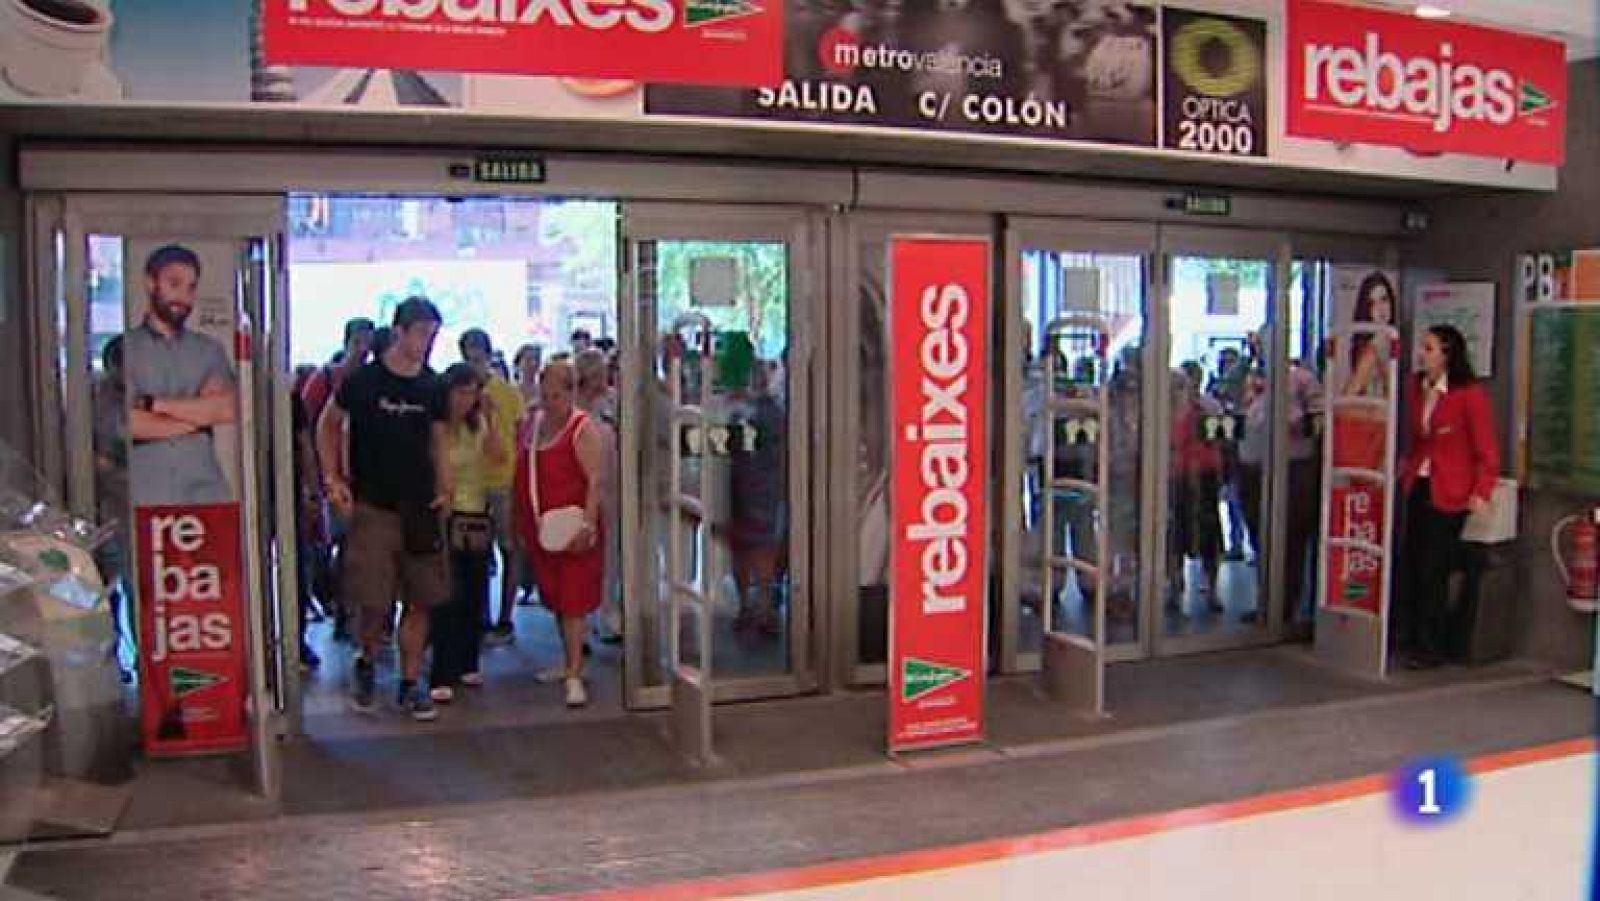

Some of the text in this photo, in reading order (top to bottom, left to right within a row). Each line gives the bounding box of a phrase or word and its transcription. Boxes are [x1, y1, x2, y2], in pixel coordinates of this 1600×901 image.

[757, 80, 1066, 128] SALIDA C/ COLÓN
[1304, 33, 1515, 132] rebajas
[1179, 120, 1253, 153] 2000
[906, 283, 969, 616] rebaixes
[152, 514, 206, 551] re
[153, 551, 222, 601] ba
[152, 606, 233, 662] jas
